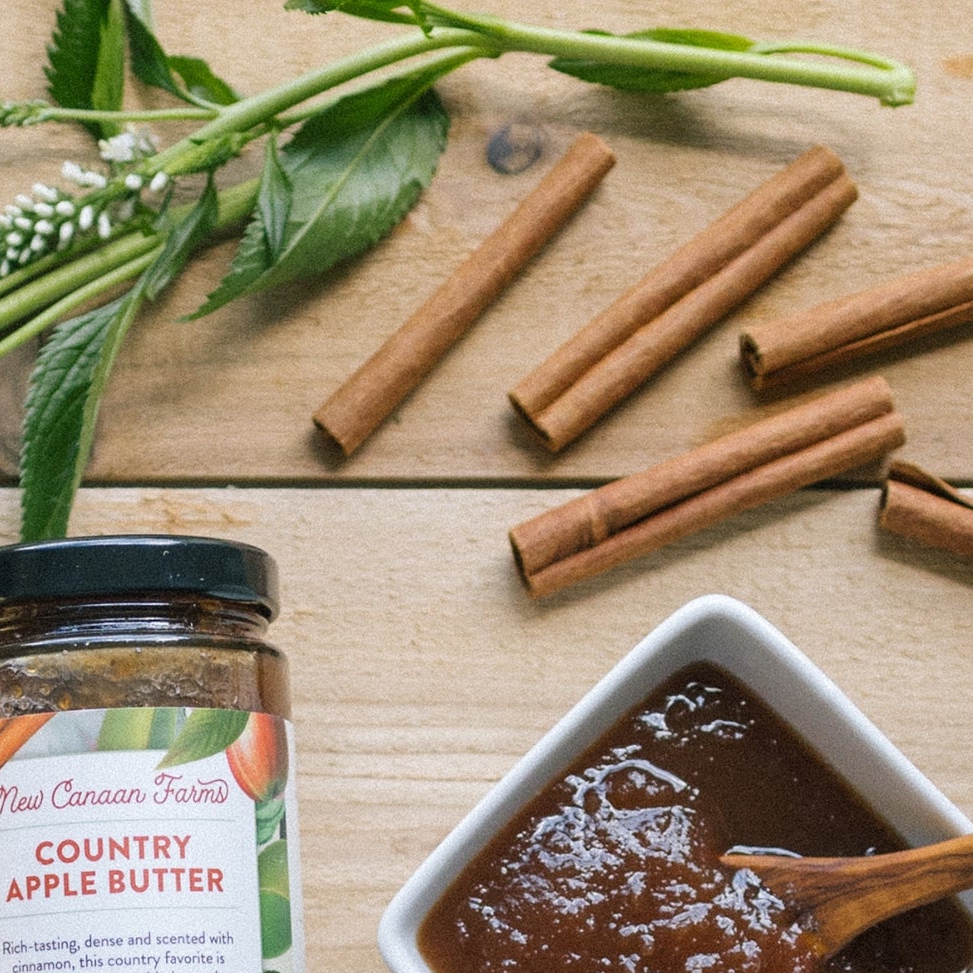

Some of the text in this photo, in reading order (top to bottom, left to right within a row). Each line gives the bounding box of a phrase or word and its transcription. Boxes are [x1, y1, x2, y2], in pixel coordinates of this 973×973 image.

[51, 779, 146, 809] Canaan
[154, 773, 228, 804] Farms
[35, 835, 191, 865] COUNTRY
[6, 868, 223, 902] APPLE BUTTER
[2, 932, 234, 955] Rich-tasting, dense and scented with
[12, 951, 225, 973] cinnamon, this country favorite is
